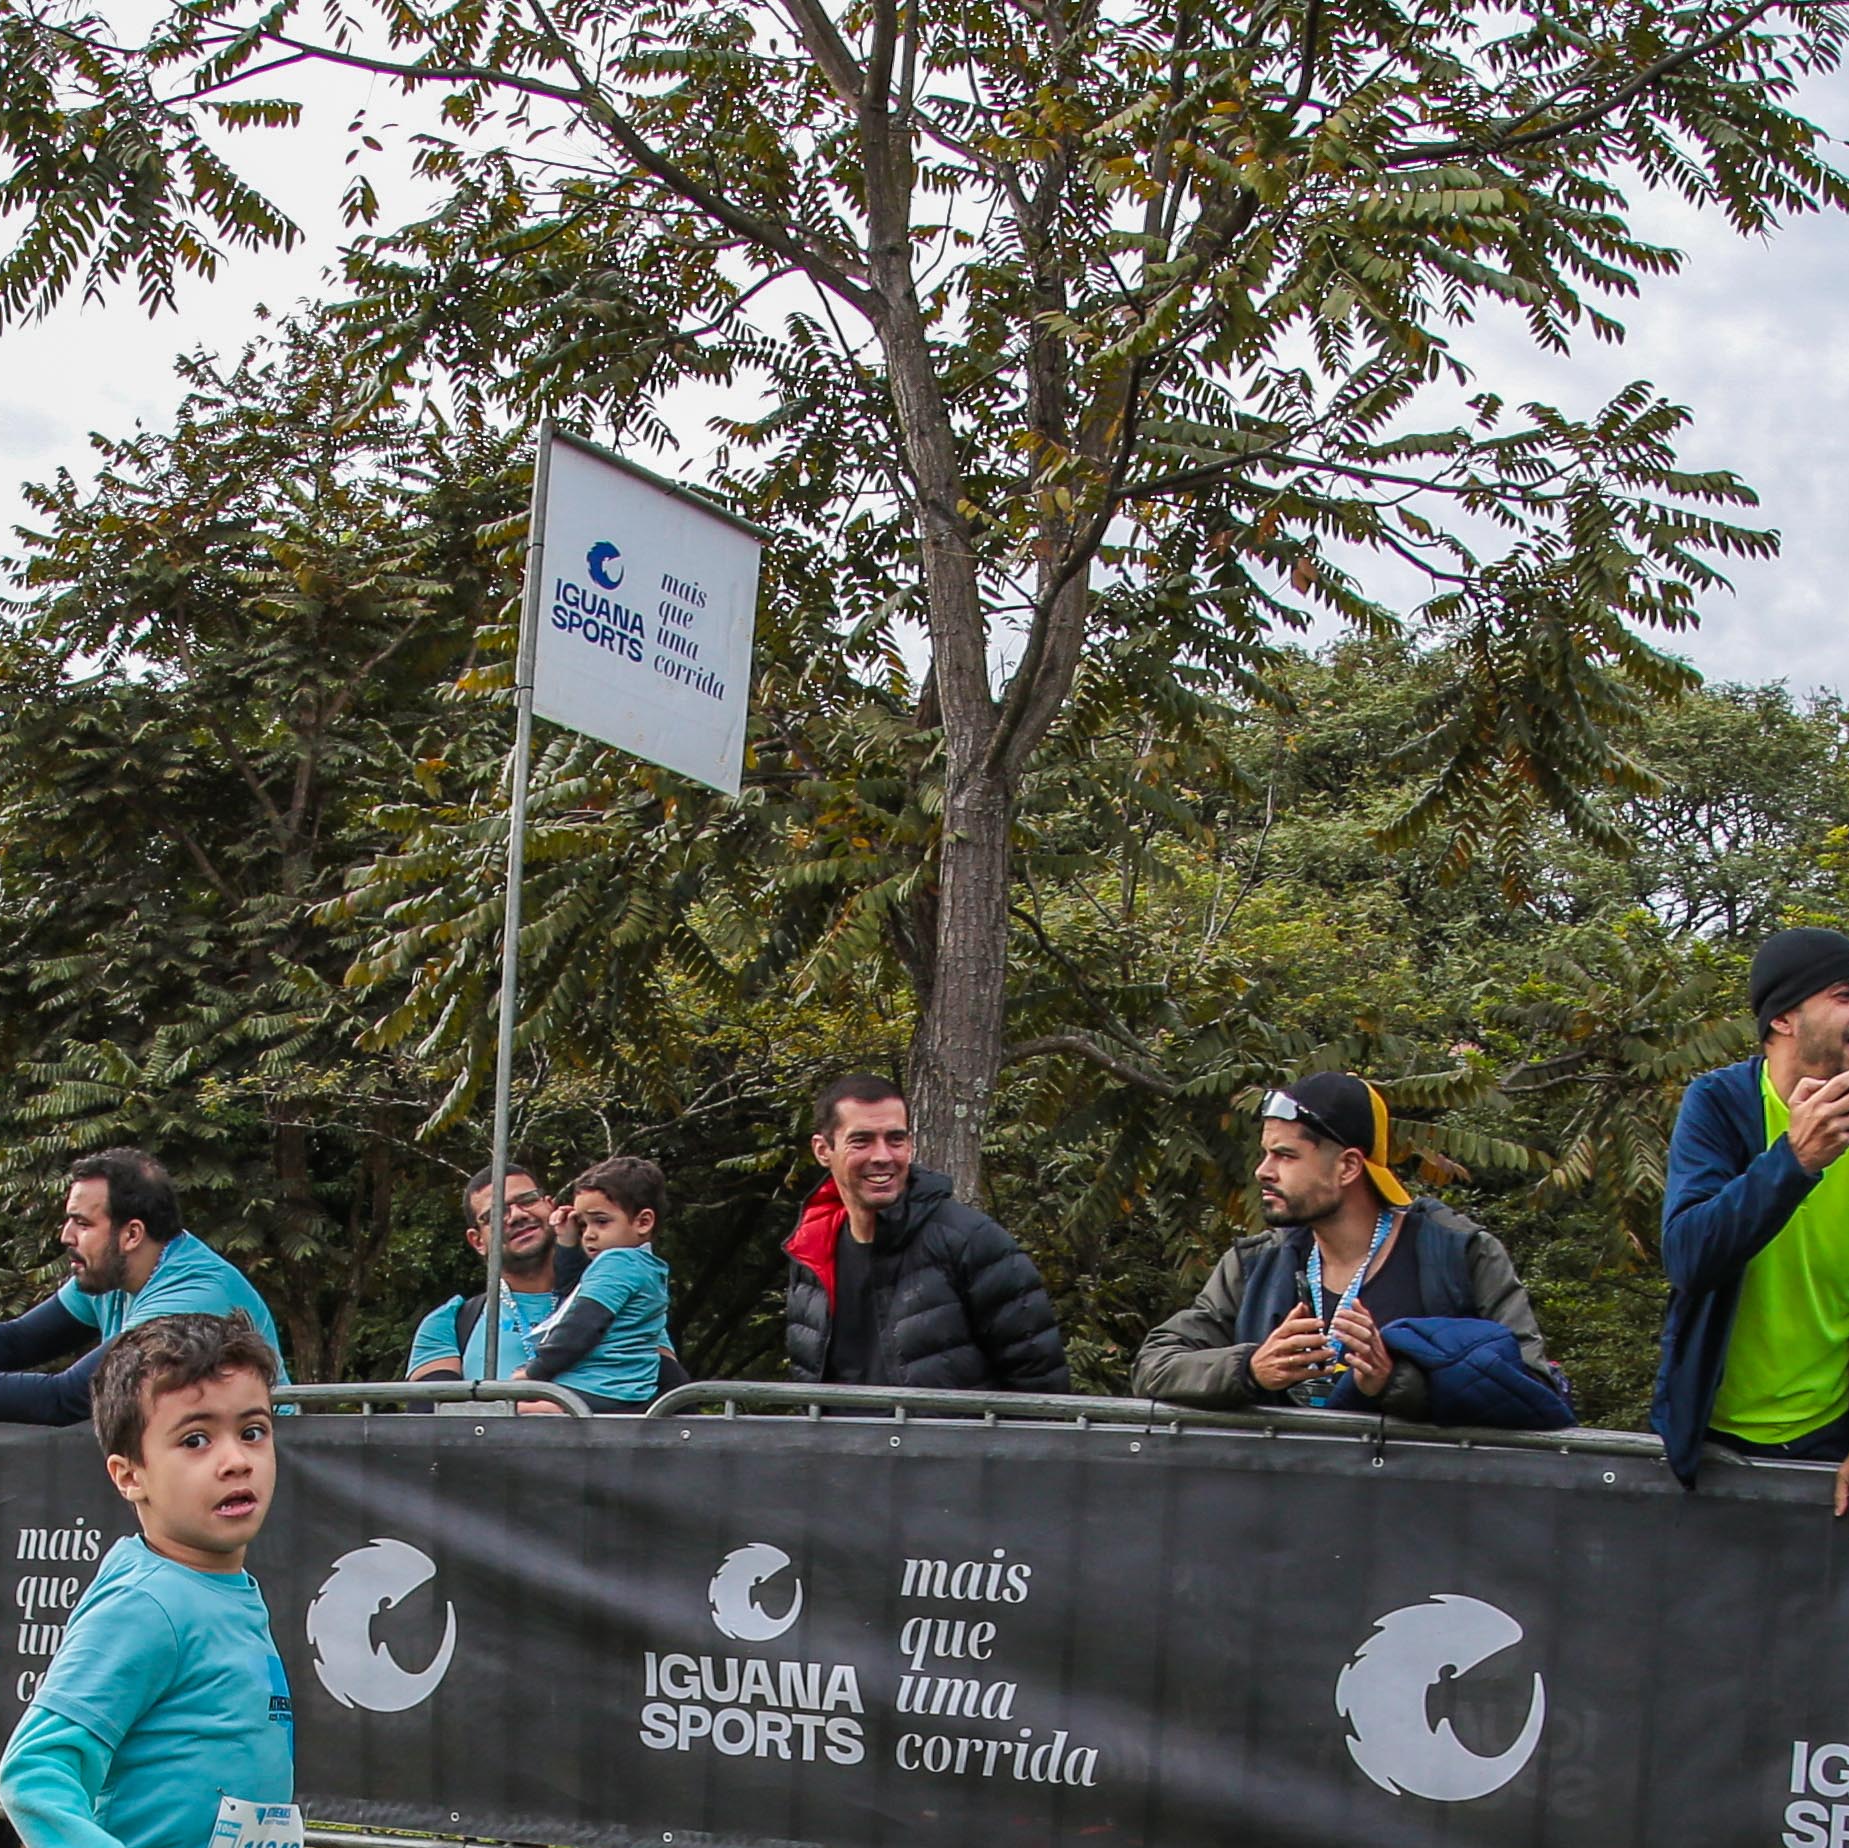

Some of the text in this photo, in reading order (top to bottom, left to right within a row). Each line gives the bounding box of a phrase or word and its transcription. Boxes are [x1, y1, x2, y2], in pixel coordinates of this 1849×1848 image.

[555, 578, 645, 639] IGUANA
[658, 597, 694, 630] que
[661, 572, 708, 609] mais
[552, 605, 644, 663] SPORTS
[656, 627, 699, 661] uma
[653, 654, 725, 701] corrida
[16, 1517, 101, 1562] mais
[15, 1575, 80, 1620] que
[900, 1548, 1033, 1605] mais
[17, 1623, 67, 1656] um
[898, 1611, 997, 1671] que
[643, 1652, 865, 1714] IGUANA
[895, 1669, 1018, 1722] uma
[639, 1703, 866, 1767] SPORTS
[895, 1726, 1100, 1788] corrida
